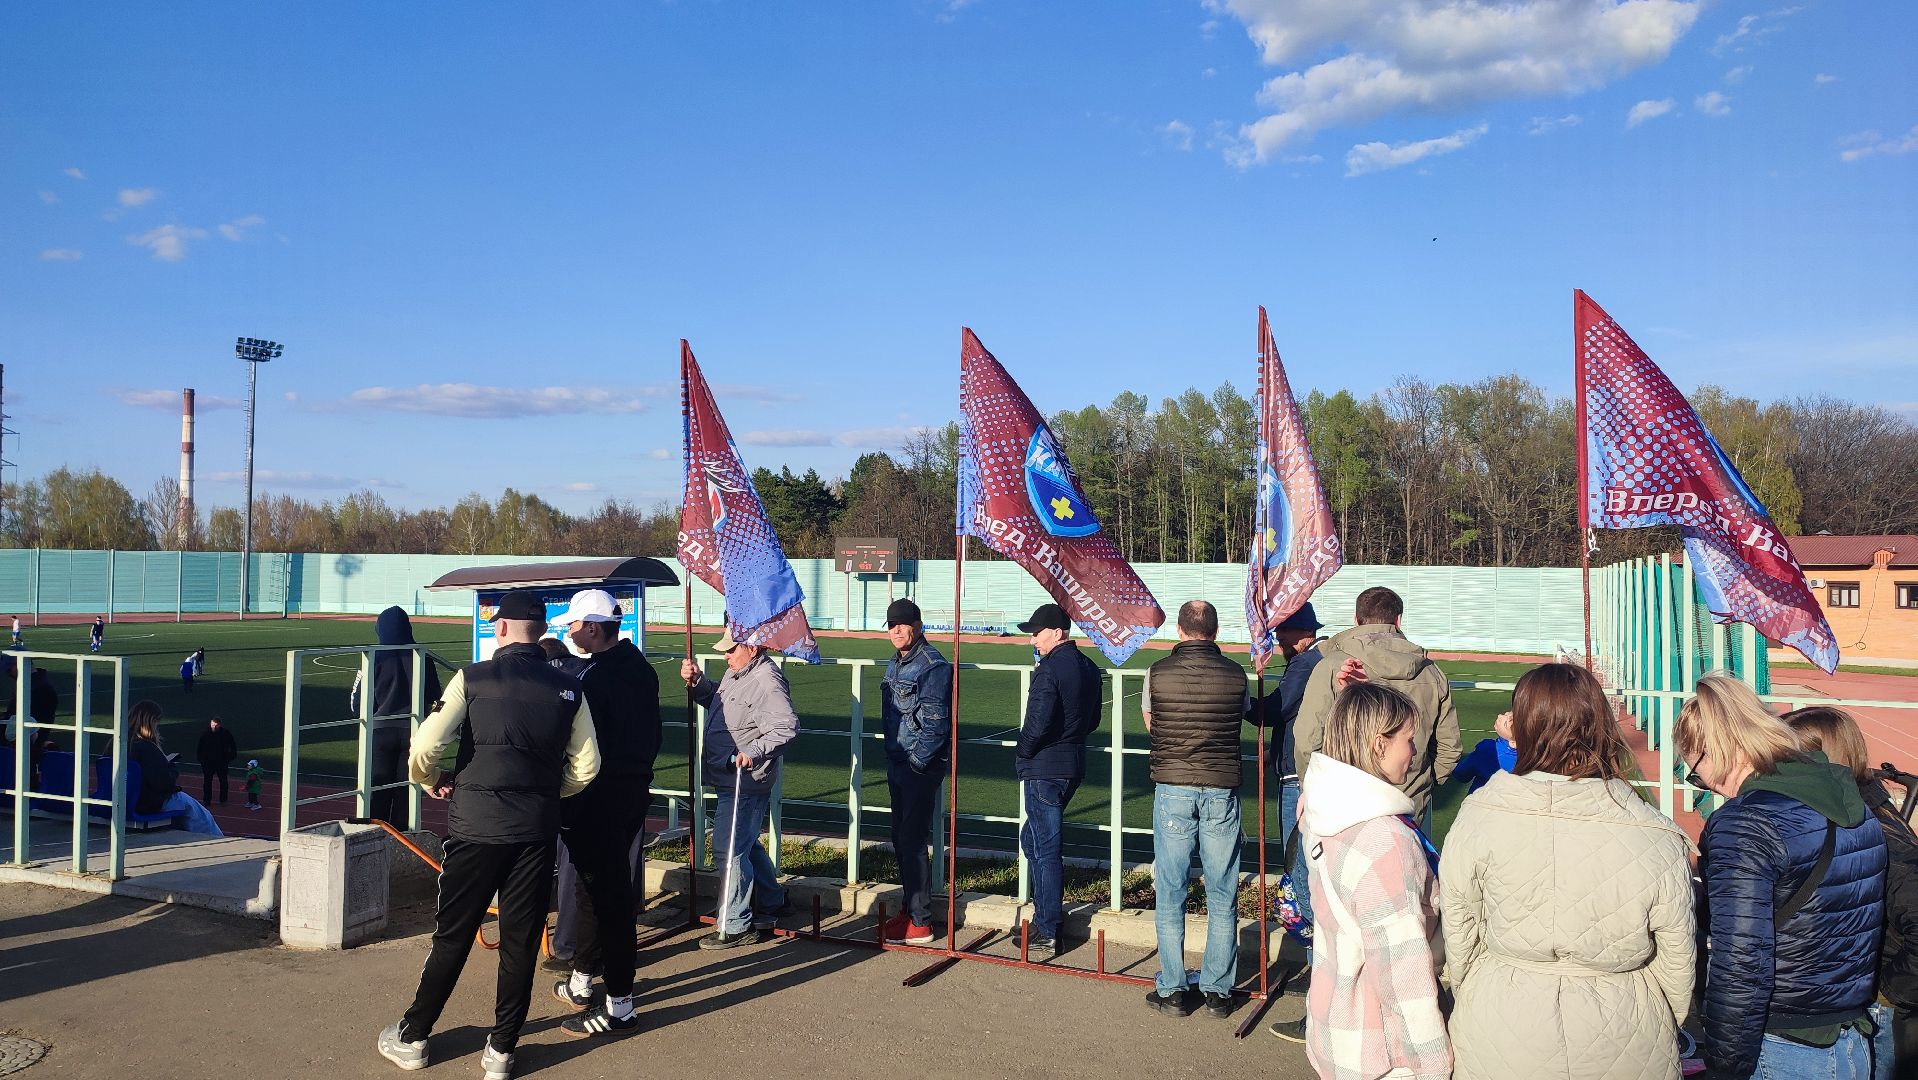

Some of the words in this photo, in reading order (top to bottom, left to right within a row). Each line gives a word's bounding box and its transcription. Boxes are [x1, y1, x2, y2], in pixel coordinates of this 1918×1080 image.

[878, 559, 886, 571] 2
[1031, 540, 1133, 644] Кашира!
[542, 596, 570, 606] Стади
